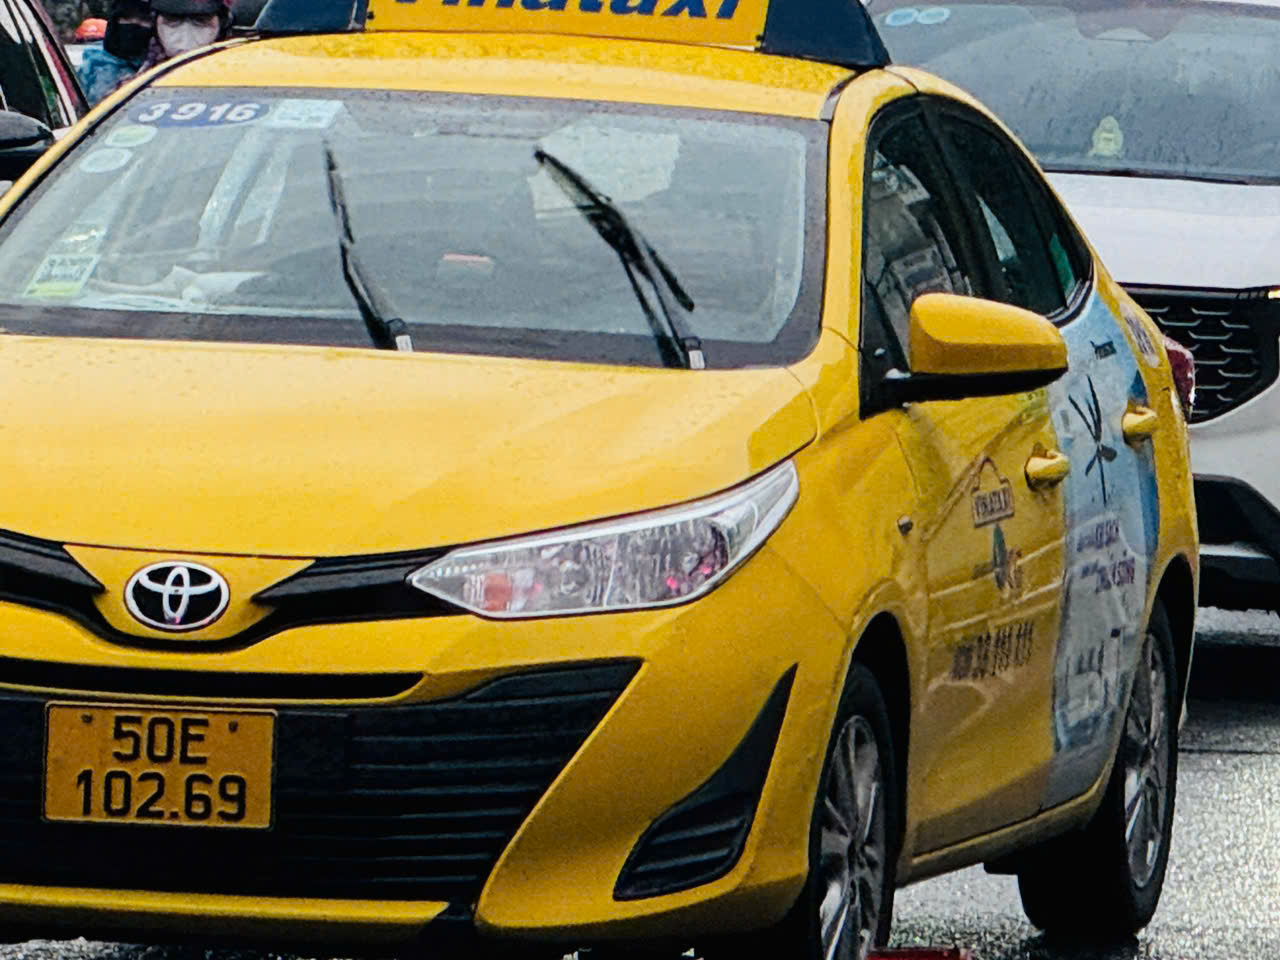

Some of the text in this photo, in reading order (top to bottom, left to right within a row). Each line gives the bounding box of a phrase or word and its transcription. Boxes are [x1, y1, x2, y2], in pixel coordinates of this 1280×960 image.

[138, 102, 258, 123] 3916
[112, 714, 209, 765] 50E
[76, 769, 247, 822] 102.69
